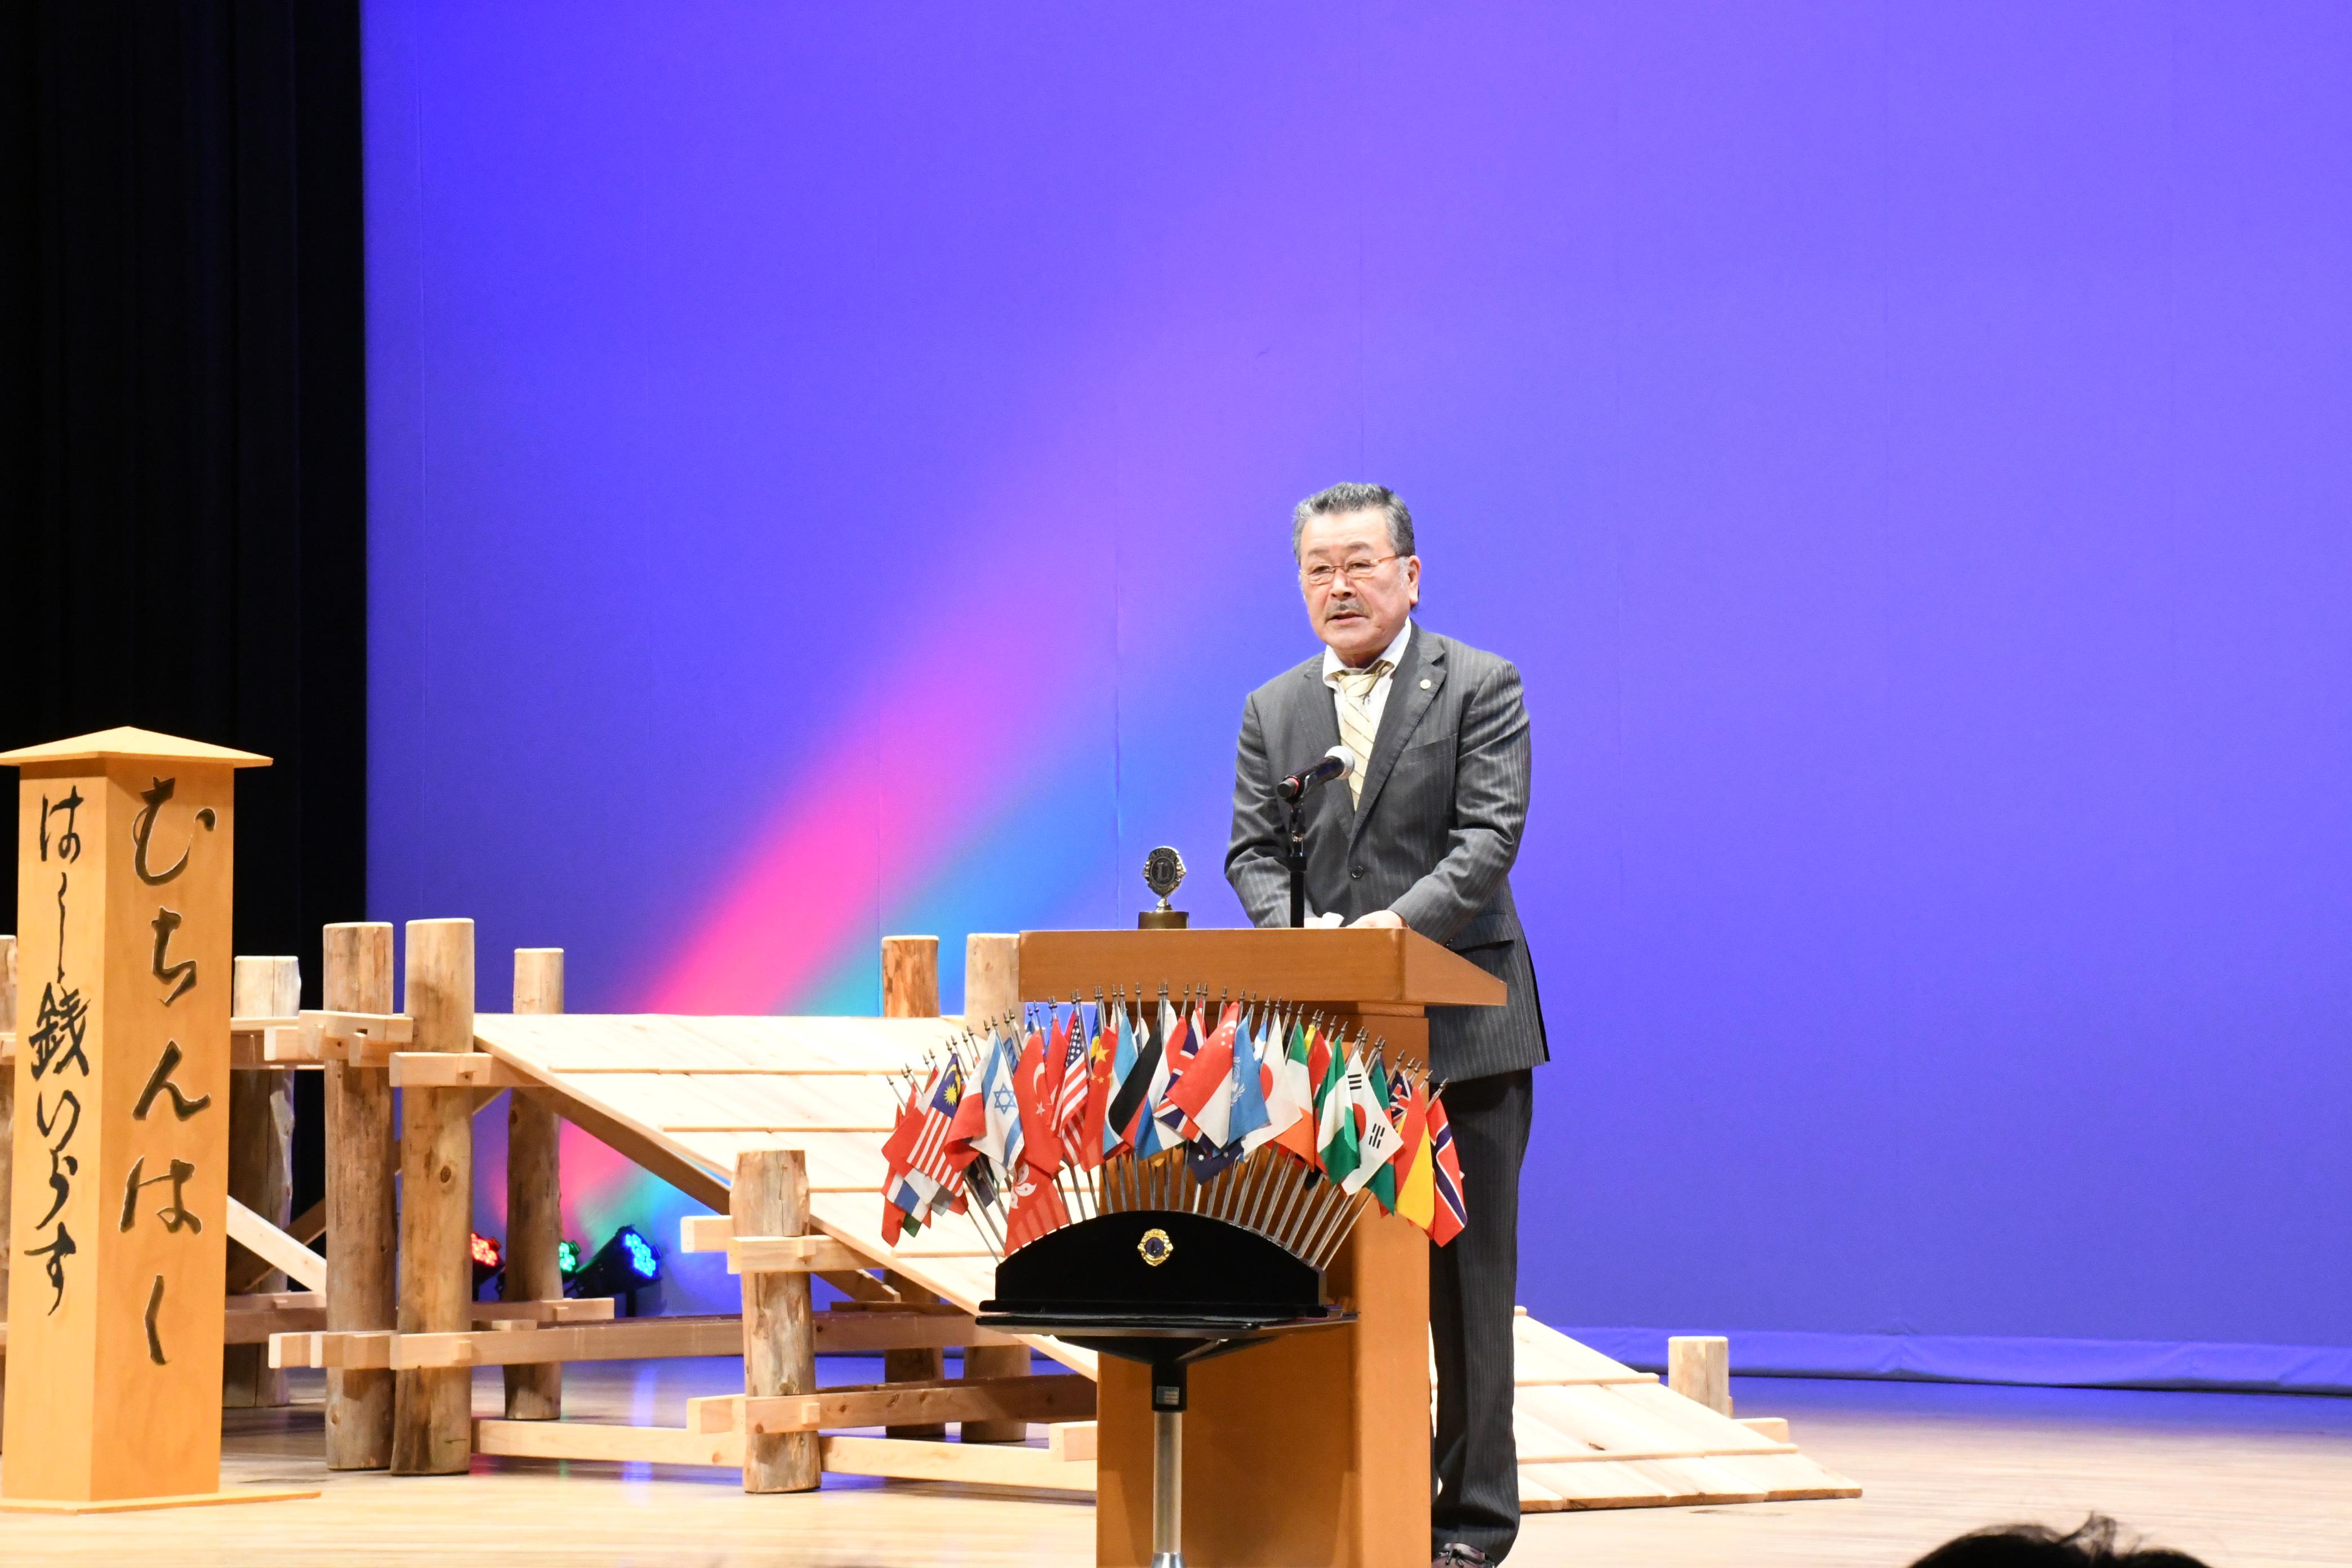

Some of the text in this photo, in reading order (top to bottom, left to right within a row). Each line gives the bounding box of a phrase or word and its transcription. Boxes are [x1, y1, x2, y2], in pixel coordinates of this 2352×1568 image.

[119, 775, 216, 1366] むちんはし
